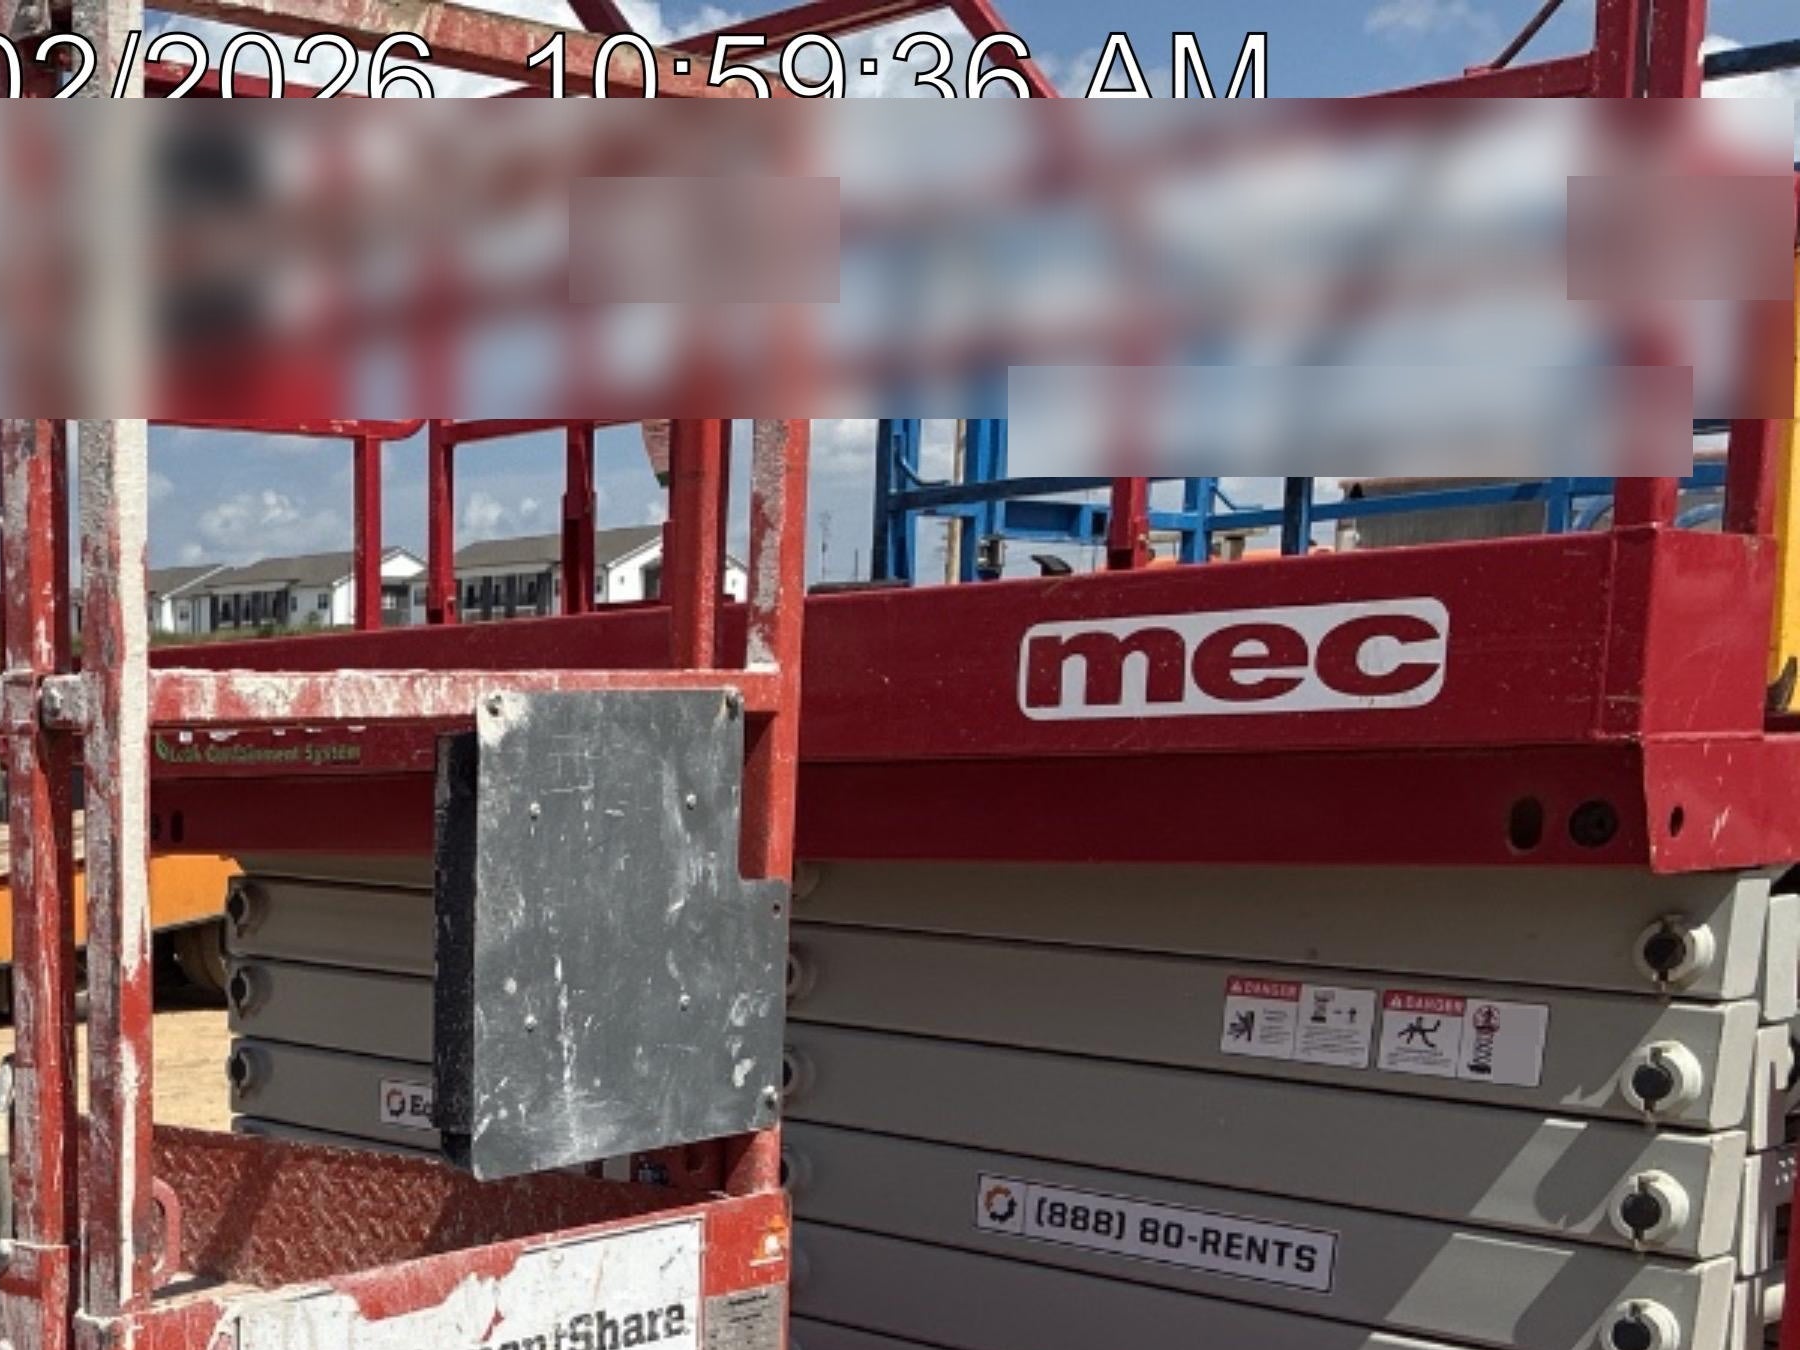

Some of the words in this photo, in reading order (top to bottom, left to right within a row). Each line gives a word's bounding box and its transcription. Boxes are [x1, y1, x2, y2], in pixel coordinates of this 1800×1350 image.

[1025, 613, 1442, 708] mec
[1244, 981, 1298, 998] DANGER
[1405, 998, 1465, 1014] DANGER
[1036, 1197, 1126, 1240] (888)
[1139, 1217, 1318, 1274] 80-RENTS
